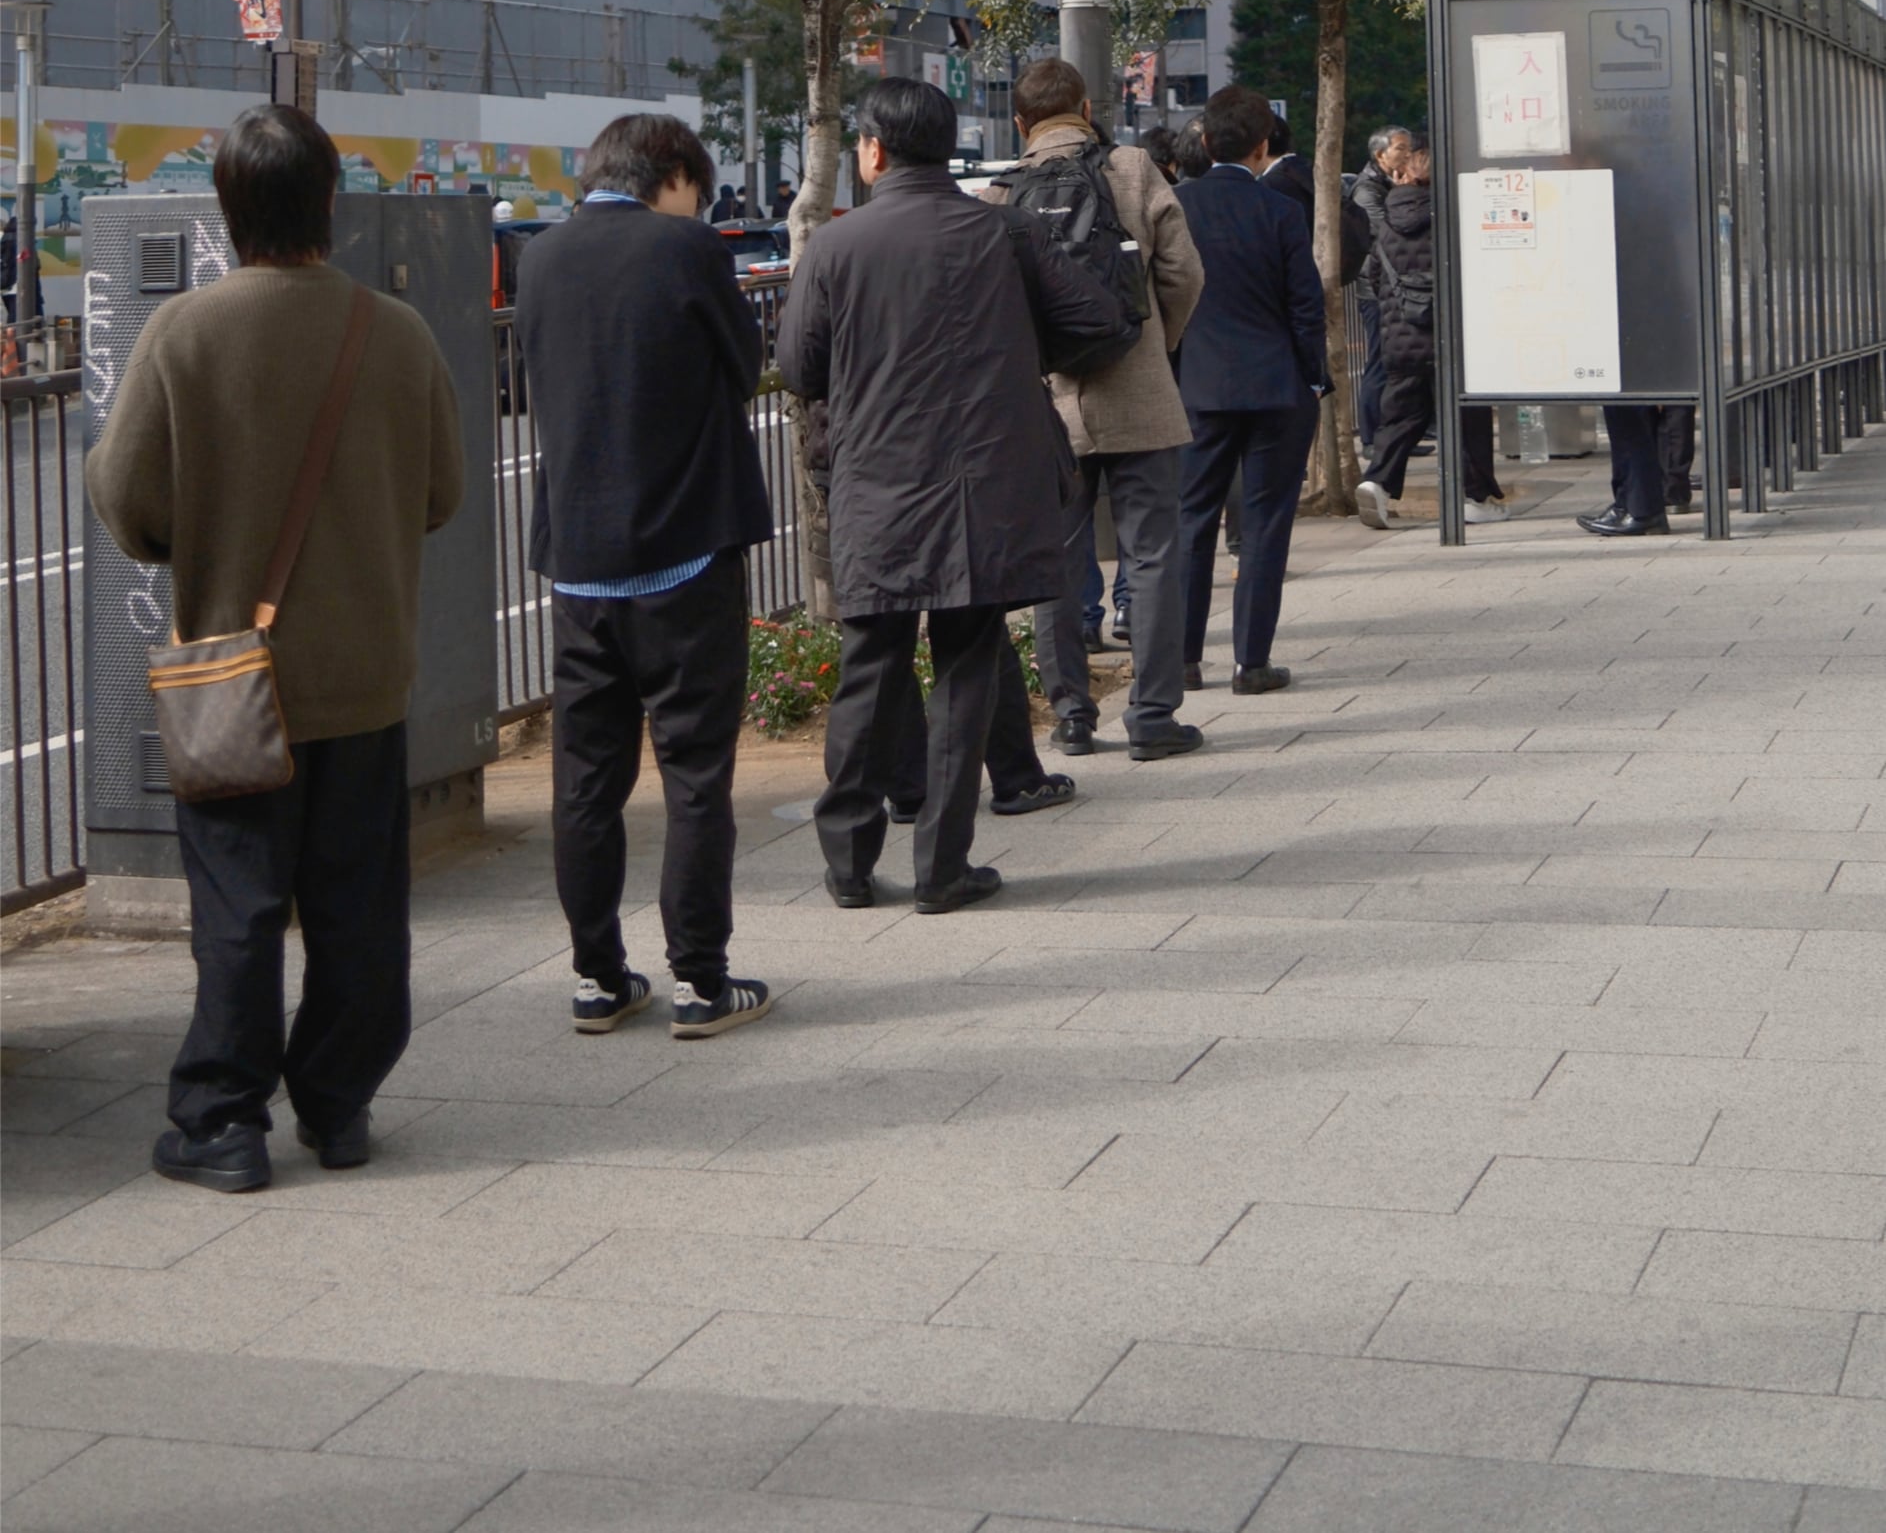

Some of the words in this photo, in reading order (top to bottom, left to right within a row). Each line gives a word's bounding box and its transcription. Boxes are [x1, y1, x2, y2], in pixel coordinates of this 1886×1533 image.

[1518, 51, 1542, 121] 入口
[1504, 92, 1513, 124] IN
[1593, 95, 1671, 112] SMOKING
[1505, 172, 1525, 192] 12
[474, 717, 494, 746] LS
